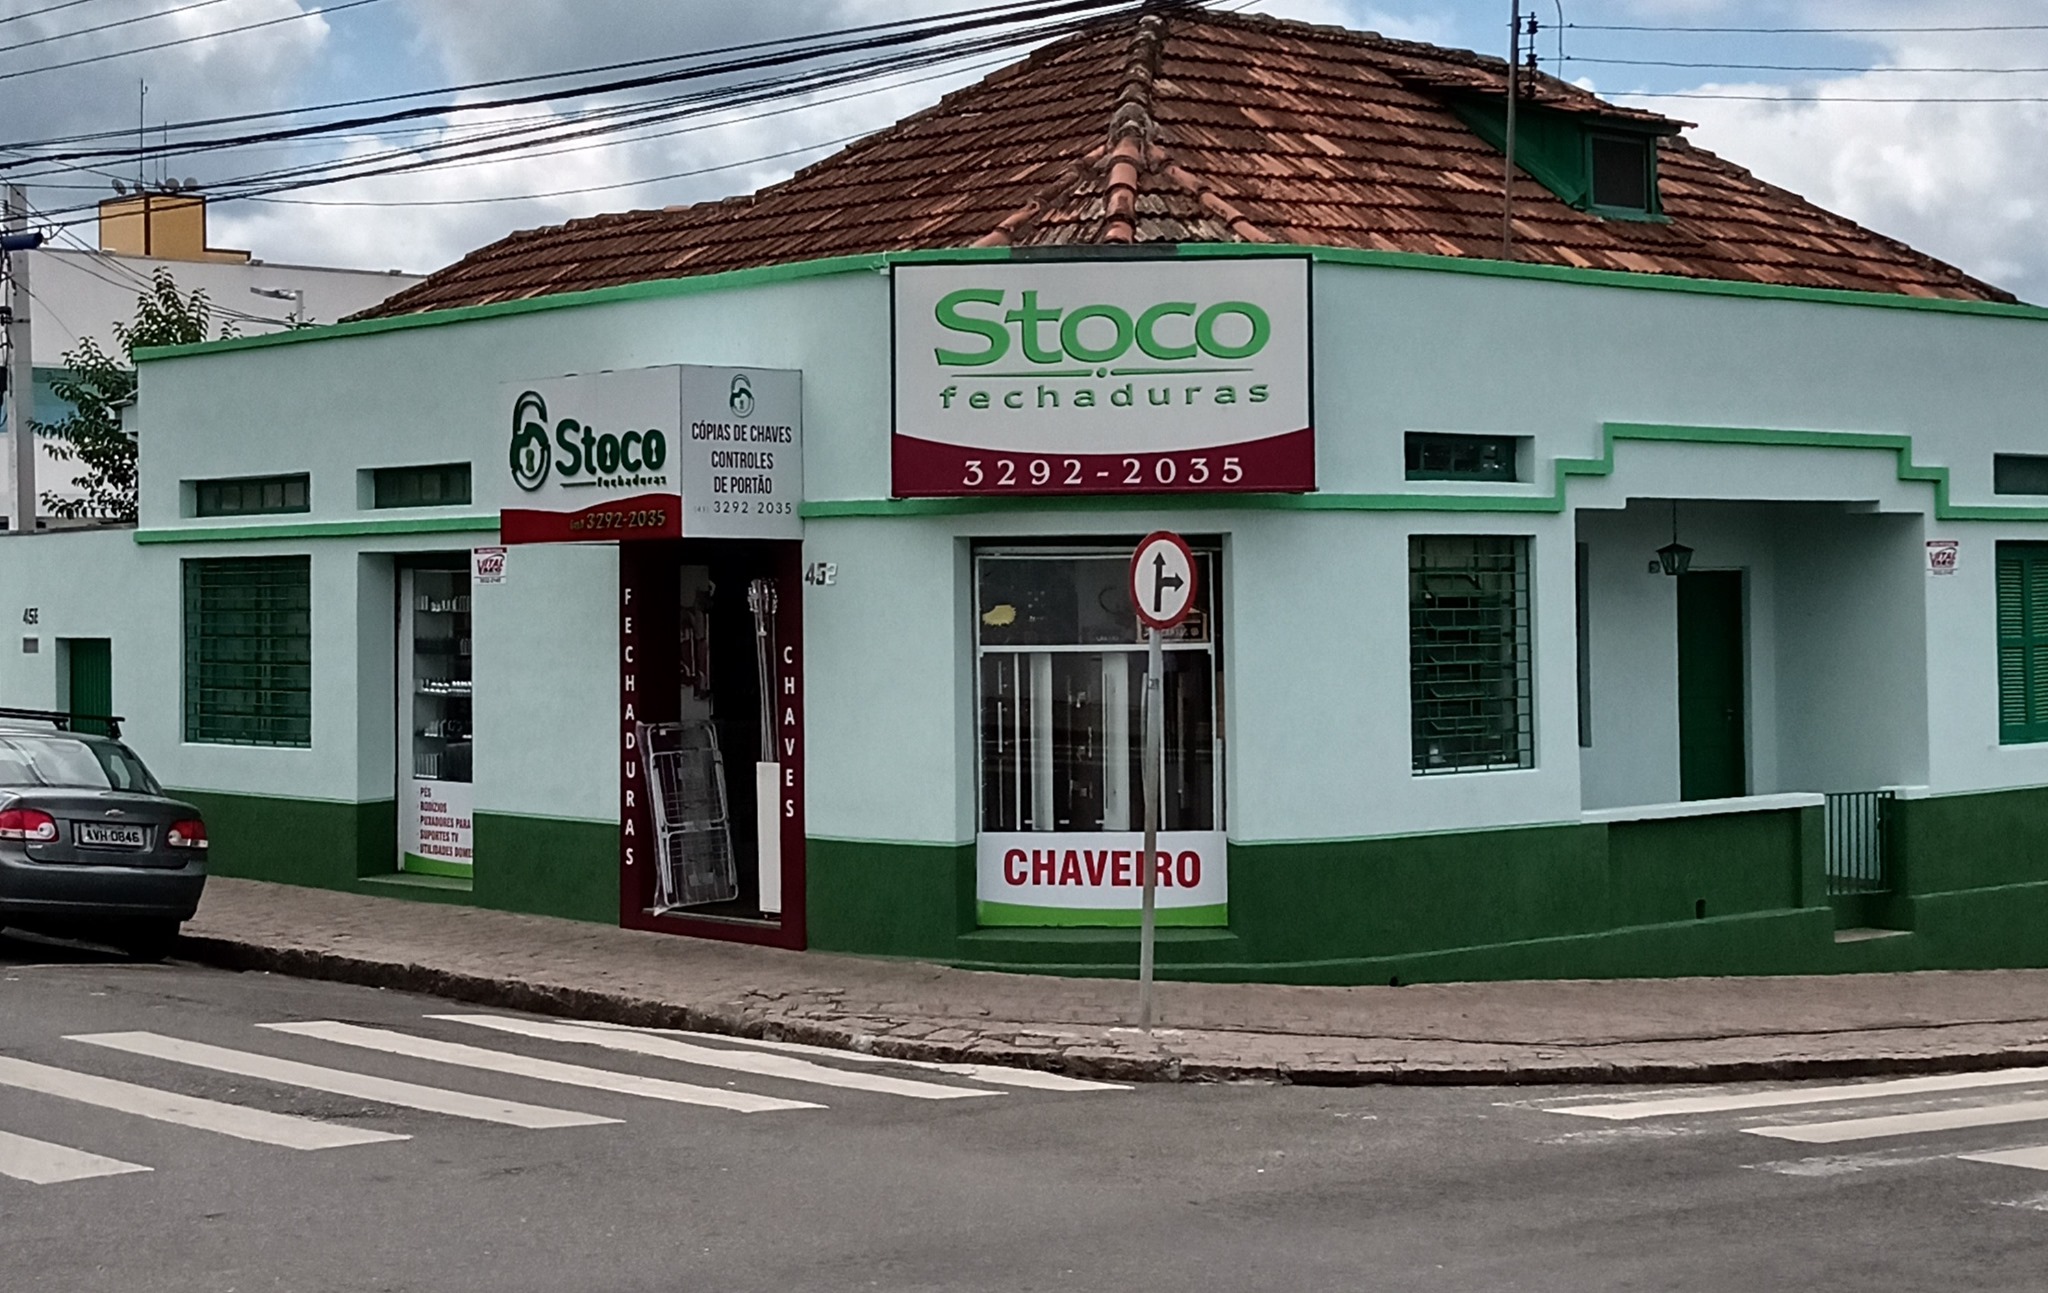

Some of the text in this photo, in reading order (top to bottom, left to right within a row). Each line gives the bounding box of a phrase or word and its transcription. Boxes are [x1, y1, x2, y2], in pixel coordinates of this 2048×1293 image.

[934, 288, 1271, 366] Stoco
[940, 384, 1270, 409] fechaduras
[692, 420, 792, 443] CÓPIAS DE CHAVES
[555, 418, 667, 476] Stoco
[711, 450, 774, 469] CONTROLES
[598, 474, 667, 488] fechaduras
[714, 474, 773, 494] DE PORTÃO
[962, 457, 1244, 486] 3292-2035
[586, 510, 666, 529] 3292-2035
[805, 562, 838, 586] 452
[624, 588, 636, 866] FECHADURAS
[783, 646, 796, 818] CHAVES
[1004, 848, 1201, 888] CHAVEIRO
